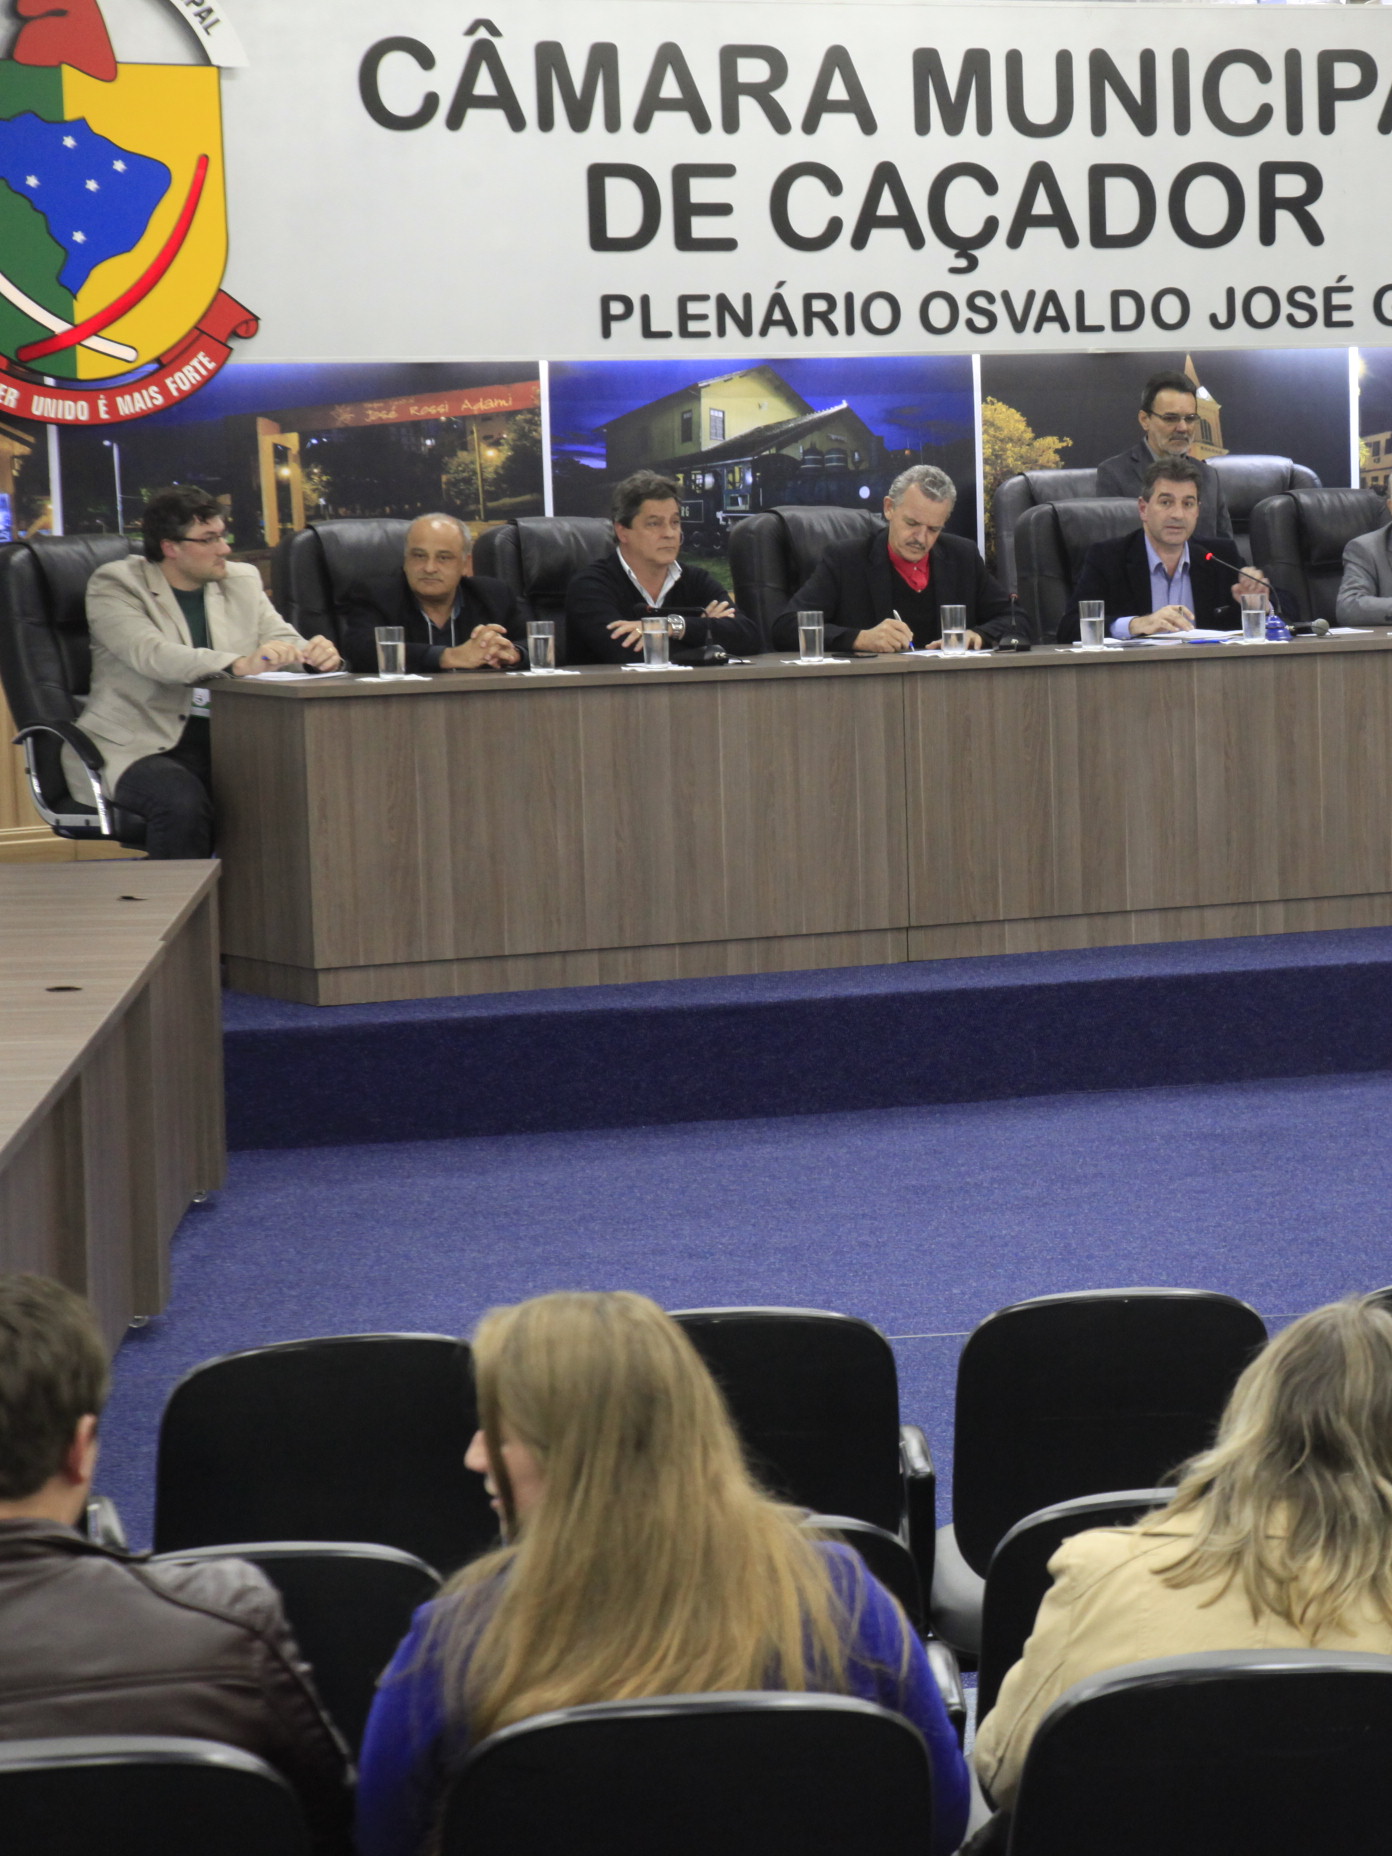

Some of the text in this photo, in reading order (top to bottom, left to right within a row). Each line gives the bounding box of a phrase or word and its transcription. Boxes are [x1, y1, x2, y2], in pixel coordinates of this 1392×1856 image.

[358, 19, 877, 134] CÂMARA
[587, 160, 1325, 273] DE CAÇADOR
[600, 280, 901, 339] PLENÁRIO
[919, 286, 1191, 335] OSVALDO
[1209, 275, 1354, 330] JOSÉ
[31, 395, 90, 421] UNIDO
[115, 386, 164, 416] MAIS
[164, 351, 217, 397] FORTE
[409, 401, 449, 417] Rossi
[461, 394, 513, 415] Adami
